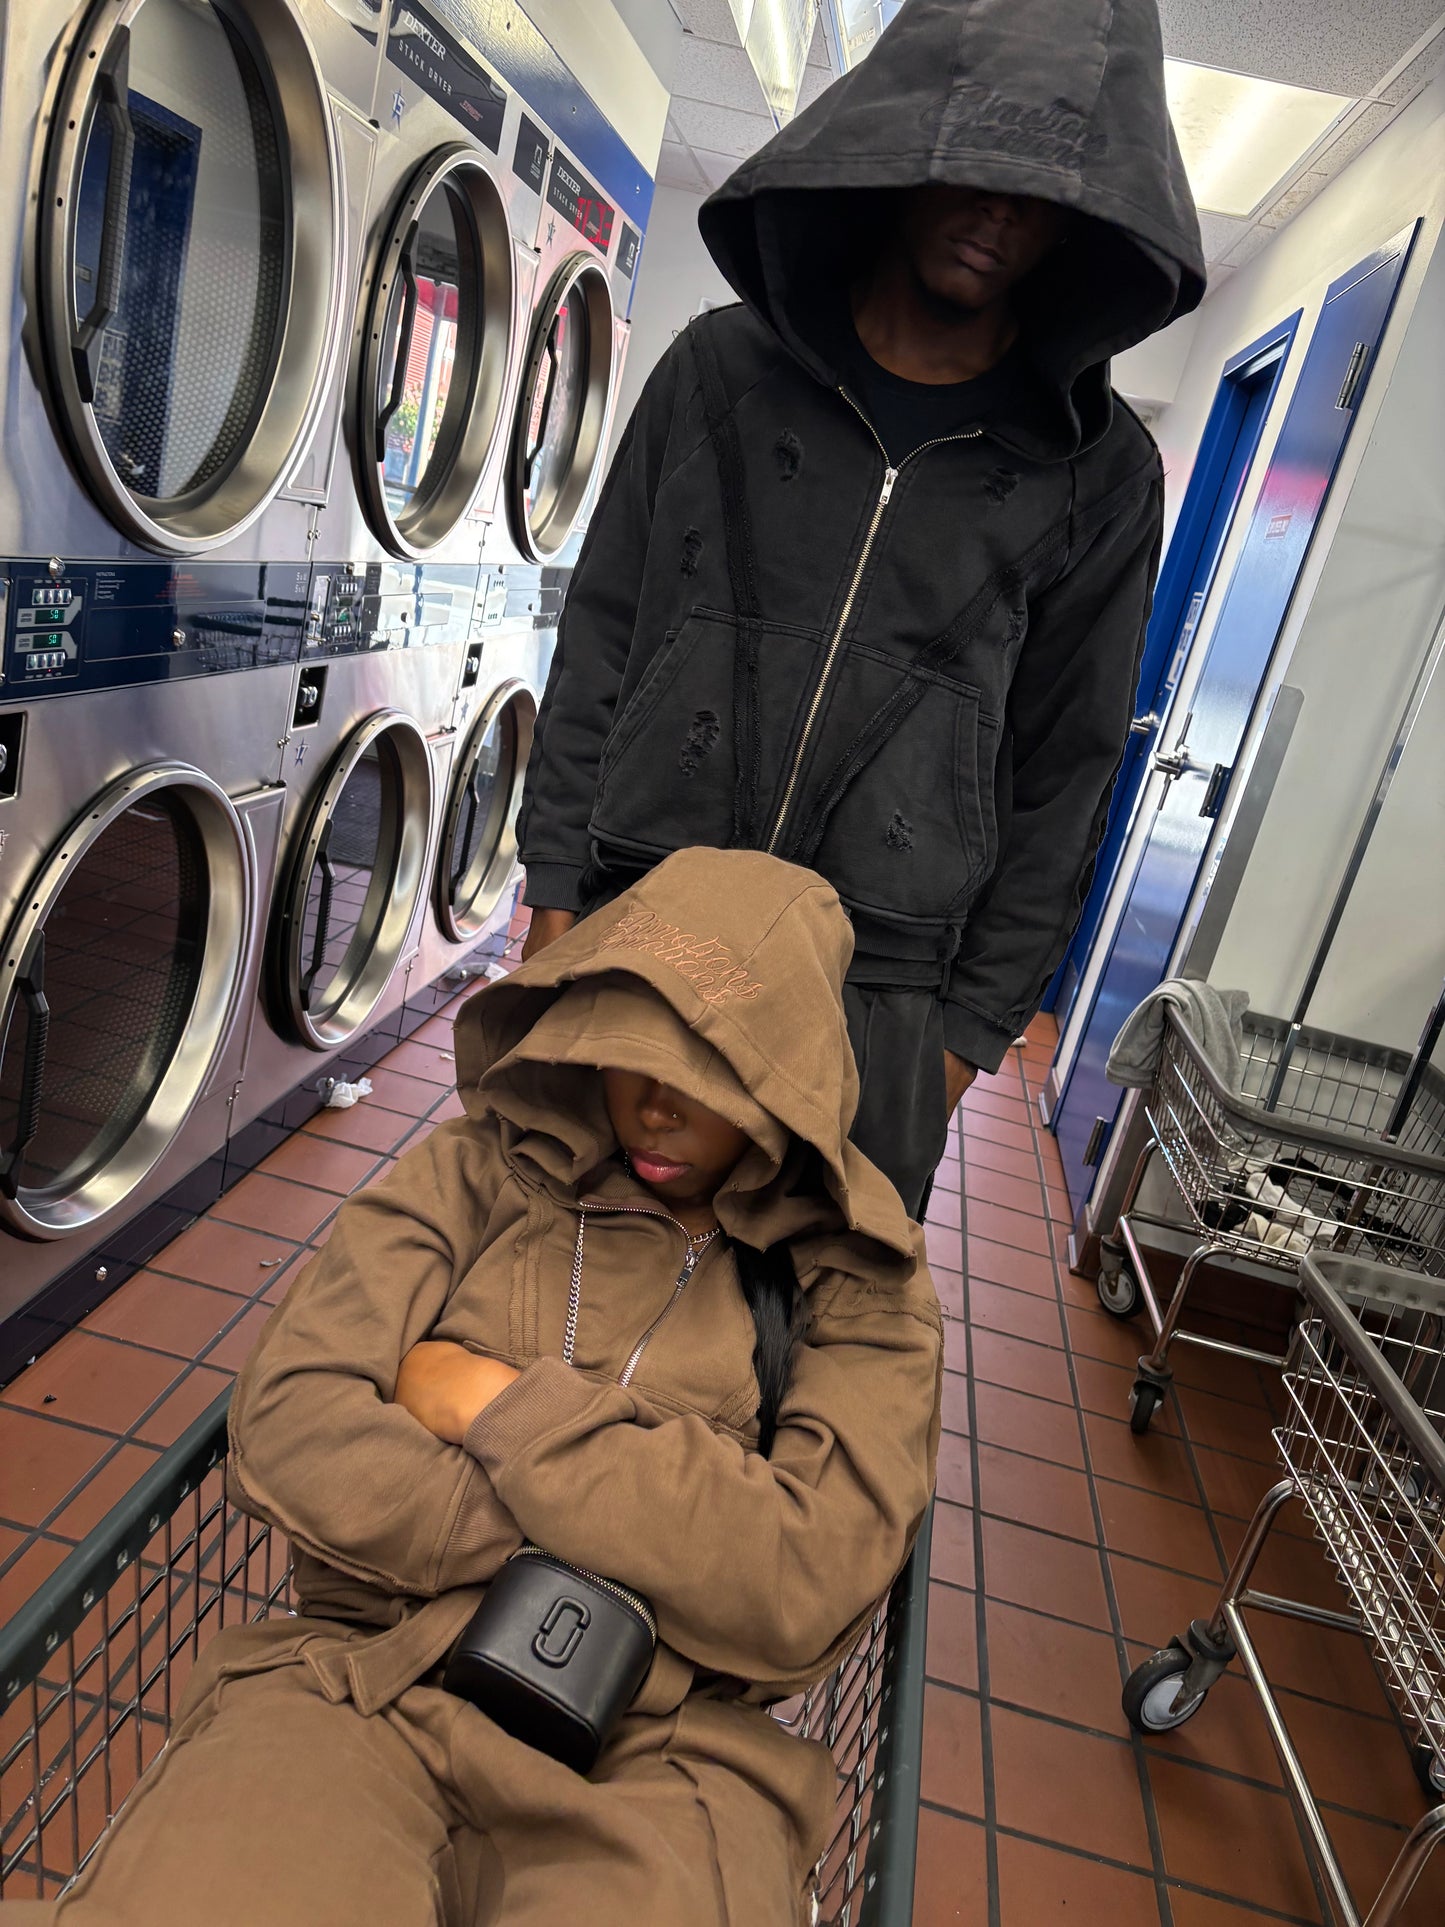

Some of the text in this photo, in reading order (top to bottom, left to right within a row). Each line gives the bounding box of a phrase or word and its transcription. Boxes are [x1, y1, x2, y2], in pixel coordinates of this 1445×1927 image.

[403, 11, 447, 61] DEXTER
[398, 39, 453, 97] STACK DRYER
[556, 166, 581, 196] DEXTER
